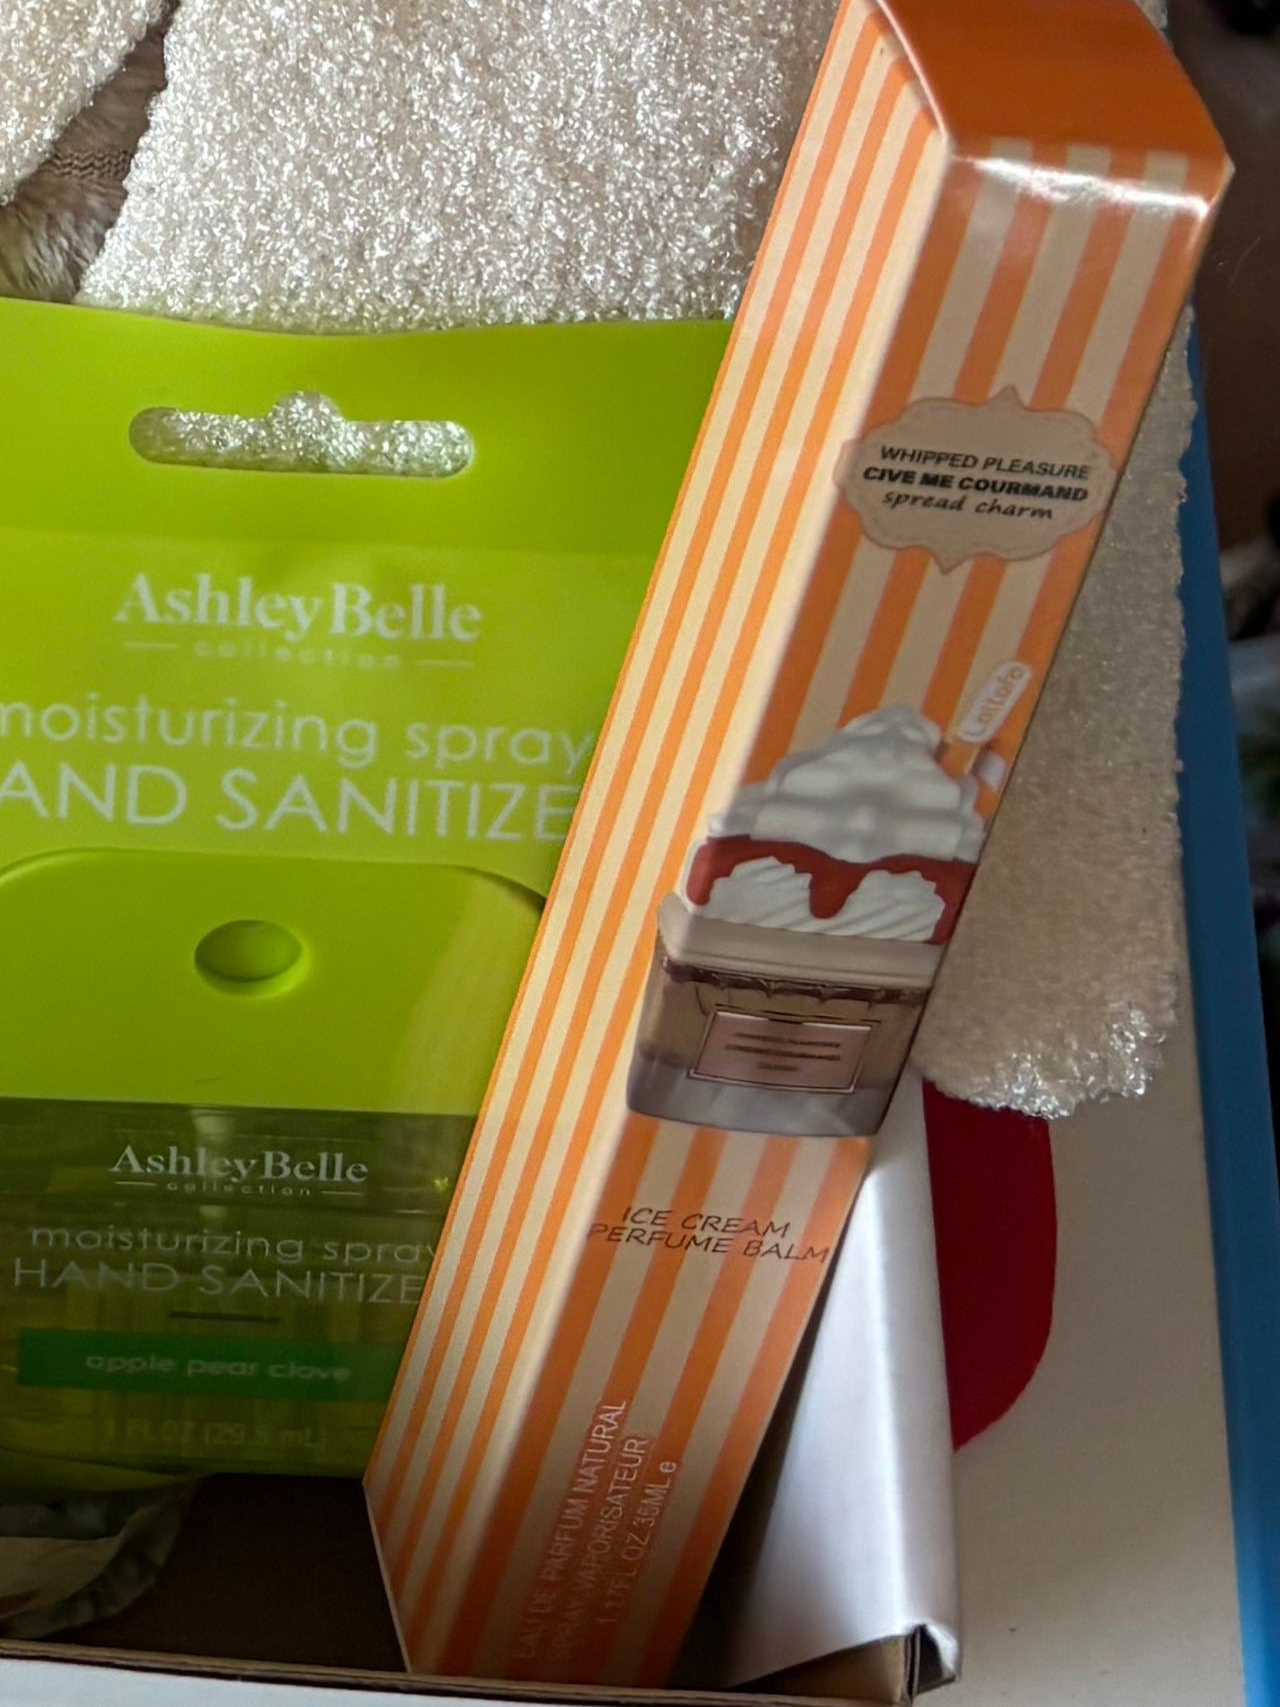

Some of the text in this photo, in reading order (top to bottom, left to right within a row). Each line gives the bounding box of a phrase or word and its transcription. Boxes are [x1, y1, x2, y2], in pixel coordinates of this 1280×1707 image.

[879, 444, 1093, 482] WHIPPED PLEASURE
[919, 472, 955, 489] ME
[882, 489, 1055, 521] spread charm
[404, 717, 598, 775] spray
[216, 767, 585, 841] SANITIZE
[589, 1222, 832, 1264] PERFUME BALM
[622, 1206, 791, 1239] ICE CREAM
[31, 1223, 304, 1265] moisturizing
[13, 1257, 425, 1305] HAND SANITIZE
[85, 1353, 352, 1383] apple pear clove
[544, 1498, 590, 1584] PARFUM
[577, 1399, 628, 1497] NATURAL
[577, 1435, 649, 1596] VAPORISATEUR
